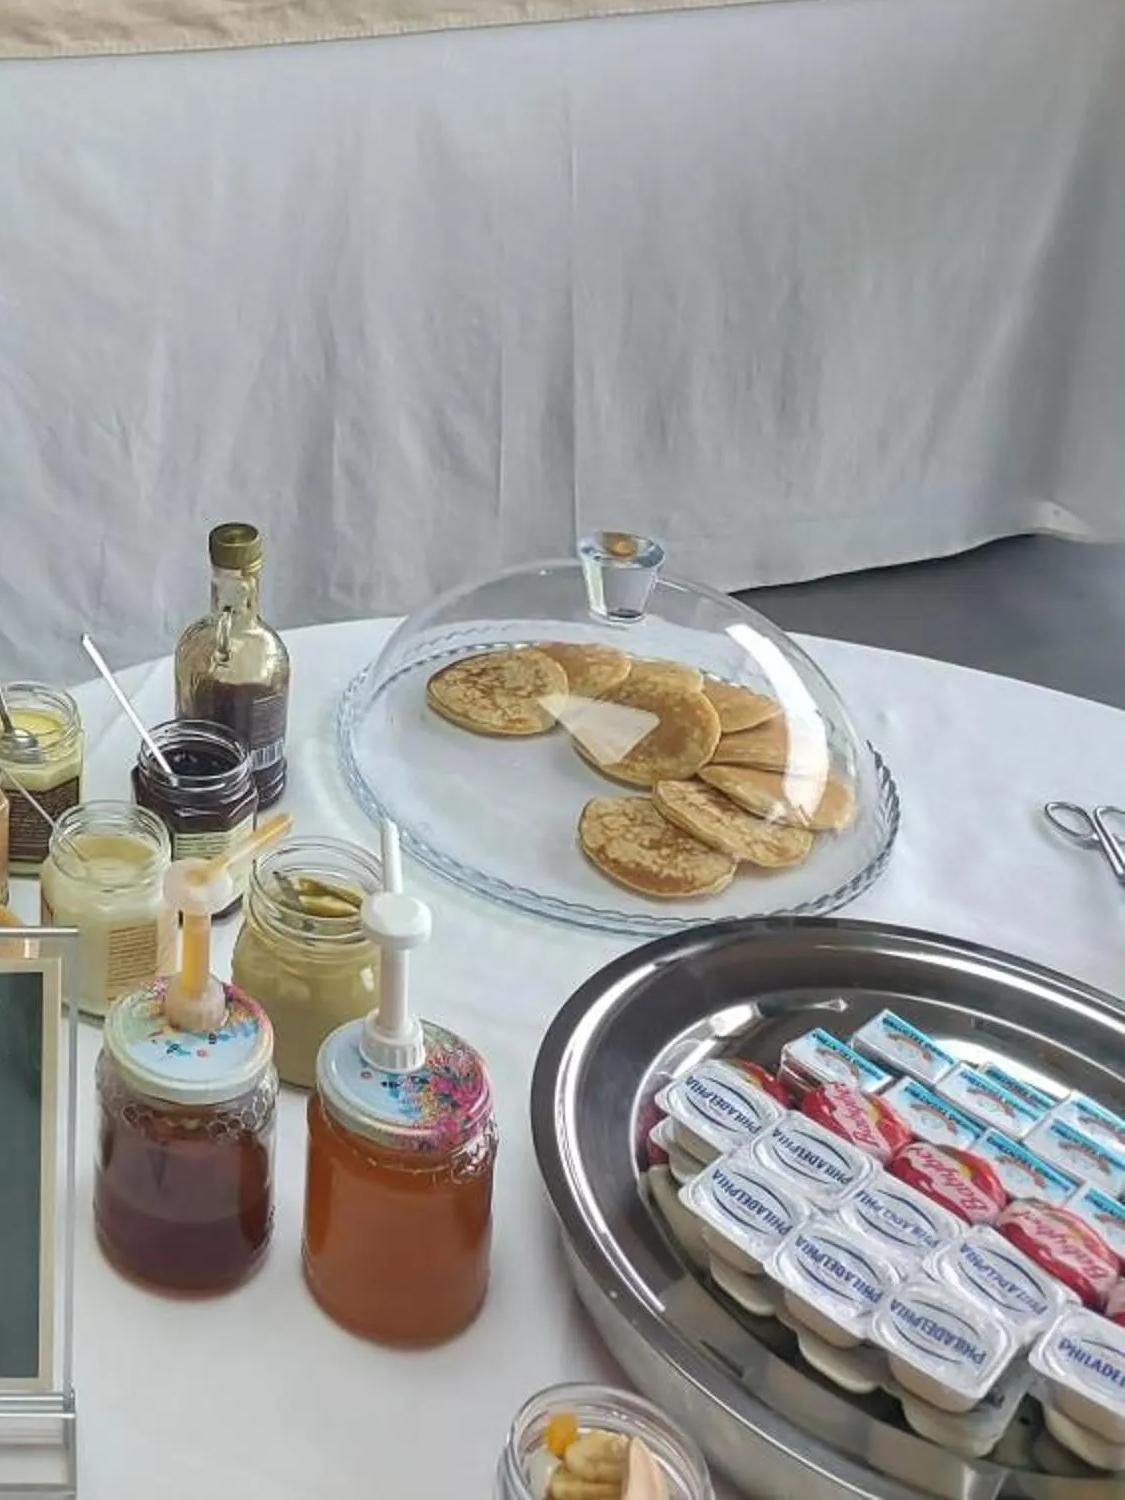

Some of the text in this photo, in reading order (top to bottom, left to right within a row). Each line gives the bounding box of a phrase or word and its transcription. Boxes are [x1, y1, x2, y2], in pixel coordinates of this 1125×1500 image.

[684, 1074, 763, 1136] PHILADELPHIA
[770, 1126, 855, 1186] PHILADELPHIA
[711, 1168, 795, 1238] PHILADELPHIA
[794, 1234, 884, 1306] PHILADELPHIA
[889, 1298, 987, 1367] PHILADELPHIA
